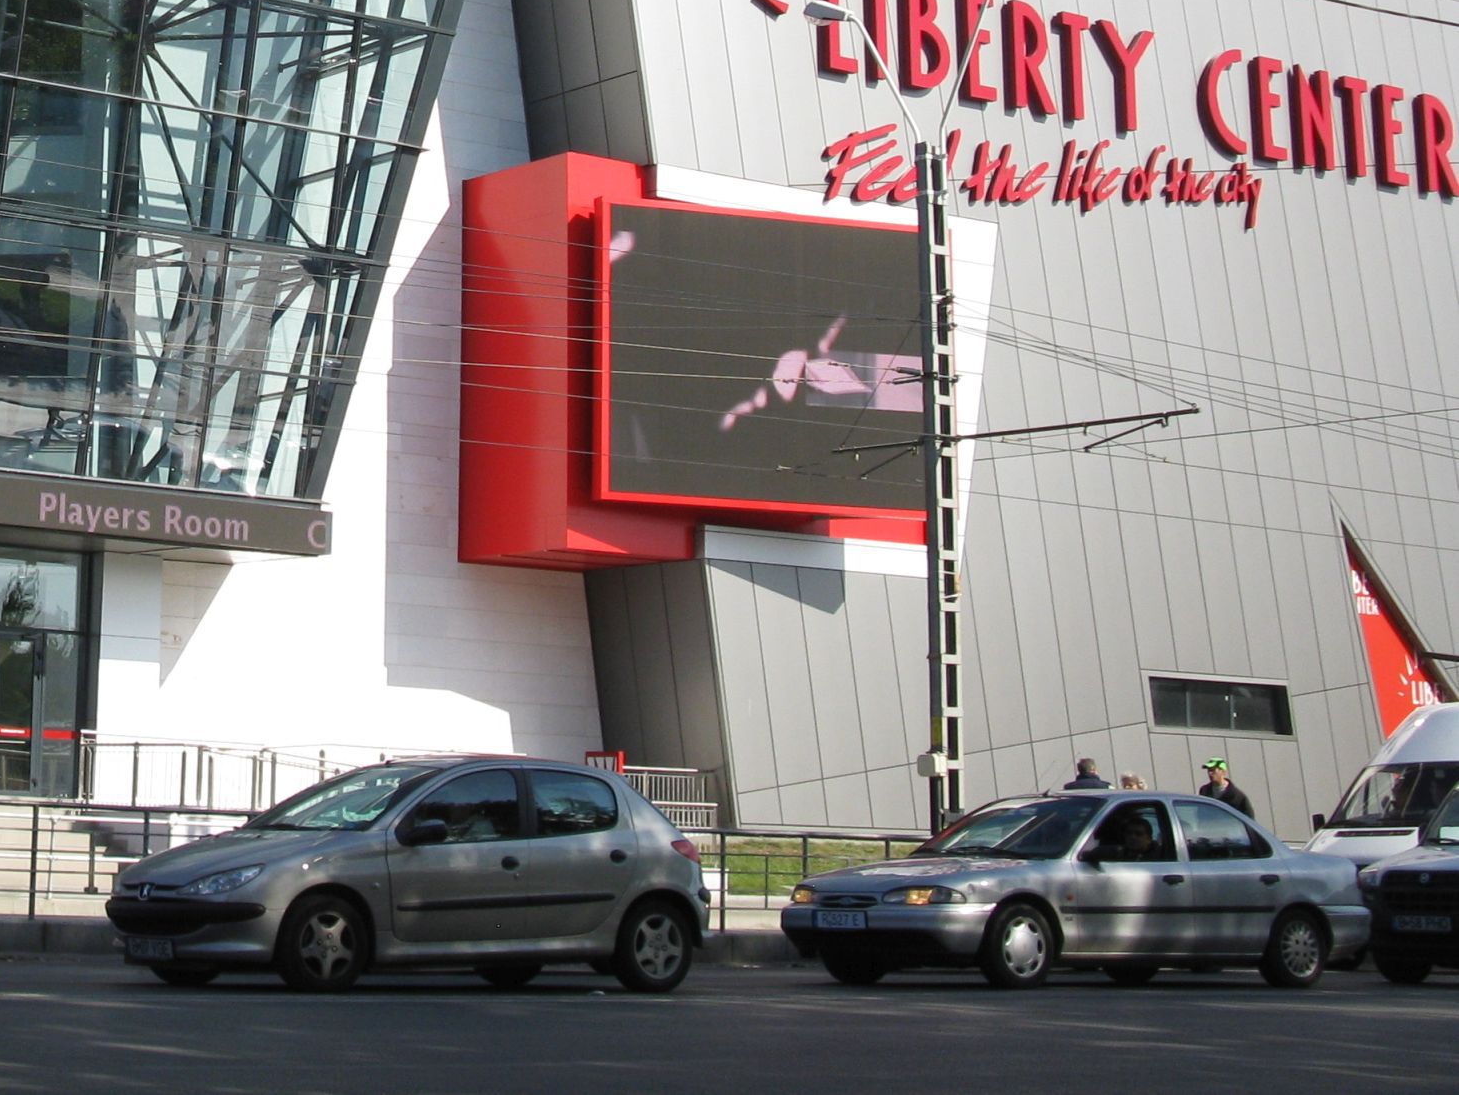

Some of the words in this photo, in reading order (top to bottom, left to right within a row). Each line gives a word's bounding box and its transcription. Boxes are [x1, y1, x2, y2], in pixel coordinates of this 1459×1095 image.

[1197, 48, 1459, 198] CENTER
[961, 140, 1049, 205] the
[1053, 138, 1119, 214] life
[1122, 144, 1167, 205] of
[1164, 156, 1215, 205] the
[1216, 159, 1263, 230] city
[39, 491, 152, 533] Players
[164, 505, 250, 542] Room
